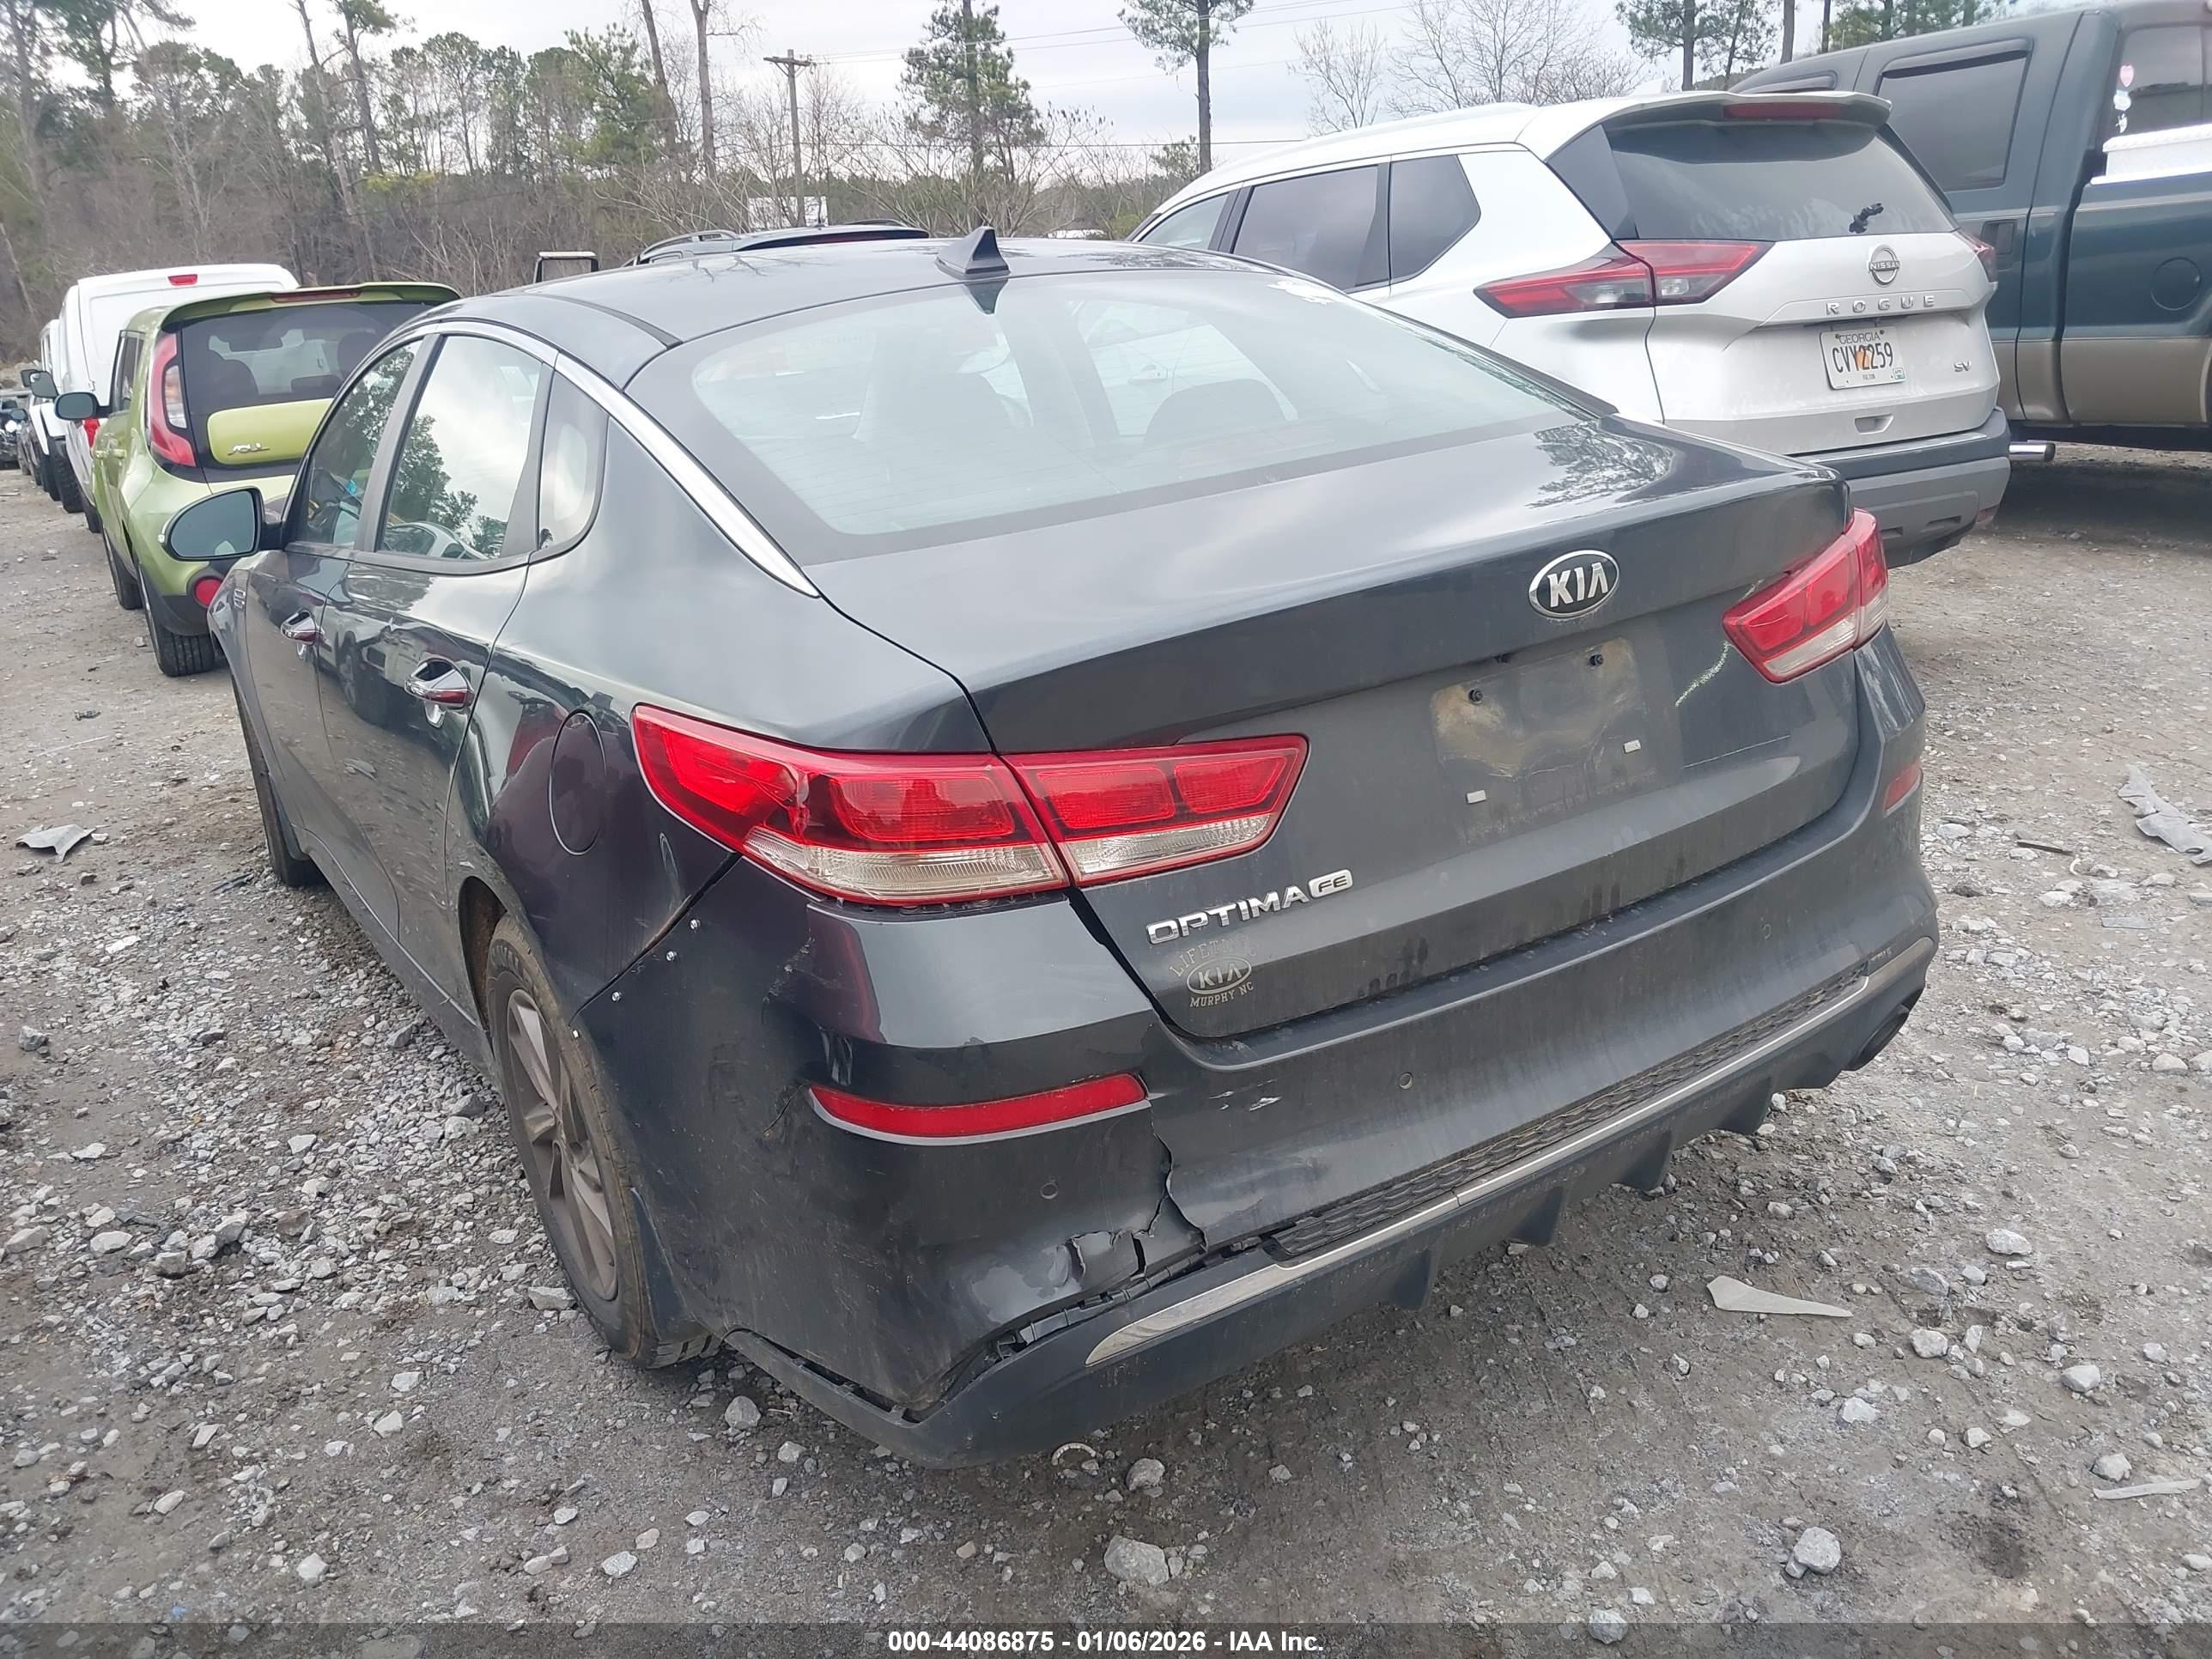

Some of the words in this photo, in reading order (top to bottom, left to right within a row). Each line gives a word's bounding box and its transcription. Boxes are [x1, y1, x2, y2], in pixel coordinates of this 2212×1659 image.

[1869, 260, 1900, 271] NISSAN
[1826, 295, 1936, 316] ROGUE
[1838, 331, 1881, 344] GEORGIA
[1832, 342, 1893, 374] CVY2259
[1954, 361, 1972, 373] SV
[1547, 562, 1608, 608] KIA
[1146, 885, 1311, 945] OPTIMA
[1317, 875, 1348, 894] FE
[1169, 938, 1256, 977] LIFETI
[1197, 963, 1243, 989] KIA
[1189, 989, 1236, 1008] MURPHY
[1238, 981, 1255, 996] NC
